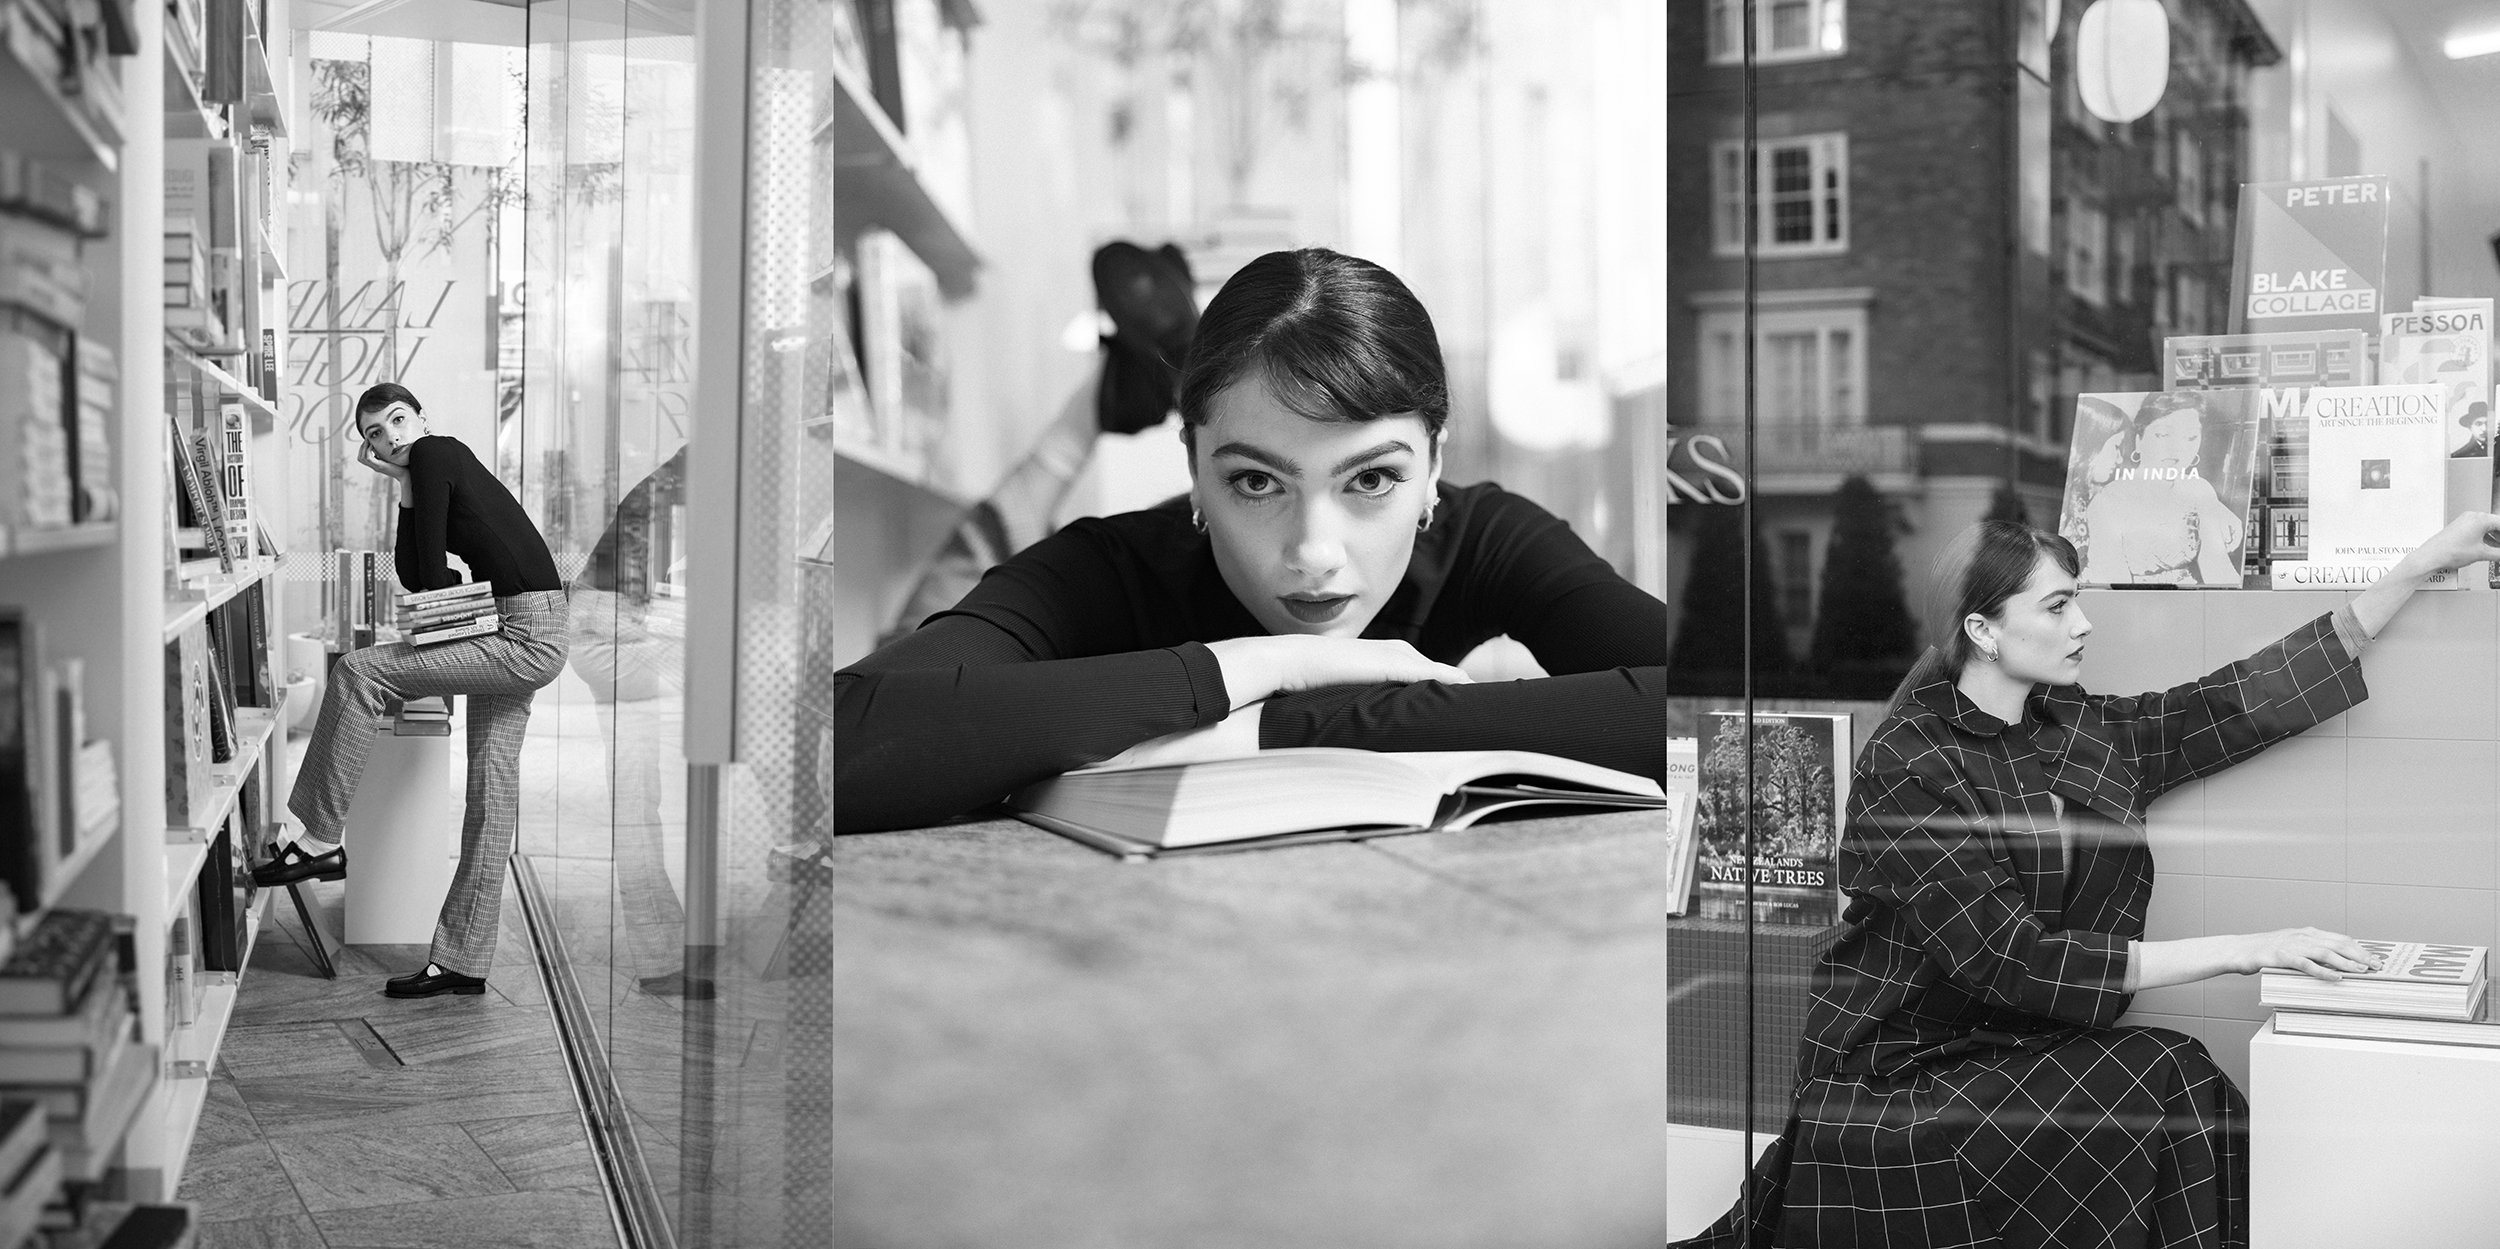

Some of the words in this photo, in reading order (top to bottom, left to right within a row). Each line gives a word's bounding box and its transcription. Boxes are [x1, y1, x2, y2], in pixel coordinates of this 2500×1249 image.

[2286, 183, 2377, 208] PETER
[2252, 269, 2347, 294] BLAKE
[2252, 292, 2372, 315] COLLAGE
[2391, 313, 2484, 336] PESSOA
[265, 358, 275, 372] LEE
[2316, 394, 2439, 419] CREATION
[2319, 419, 2337, 428] ART
[2337, 418, 2364, 427] SINCE
[2366, 417, 2385, 426] THE
[2386, 416, 2438, 426] BEGINNING
[194, 437, 209, 469] Virgil
[226, 431, 242, 453] THE
[227, 465, 245, 498] OF
[2114, 467, 2135, 481] IN
[2143, 466, 2200, 481] INDIA
[1668, 763, 1696, 773] ONG
[1753, 855, 1804, 868] ZEALAND'S
[1774, 869, 1825, 887] TREES
[2408, 944, 2475, 979] MAU
